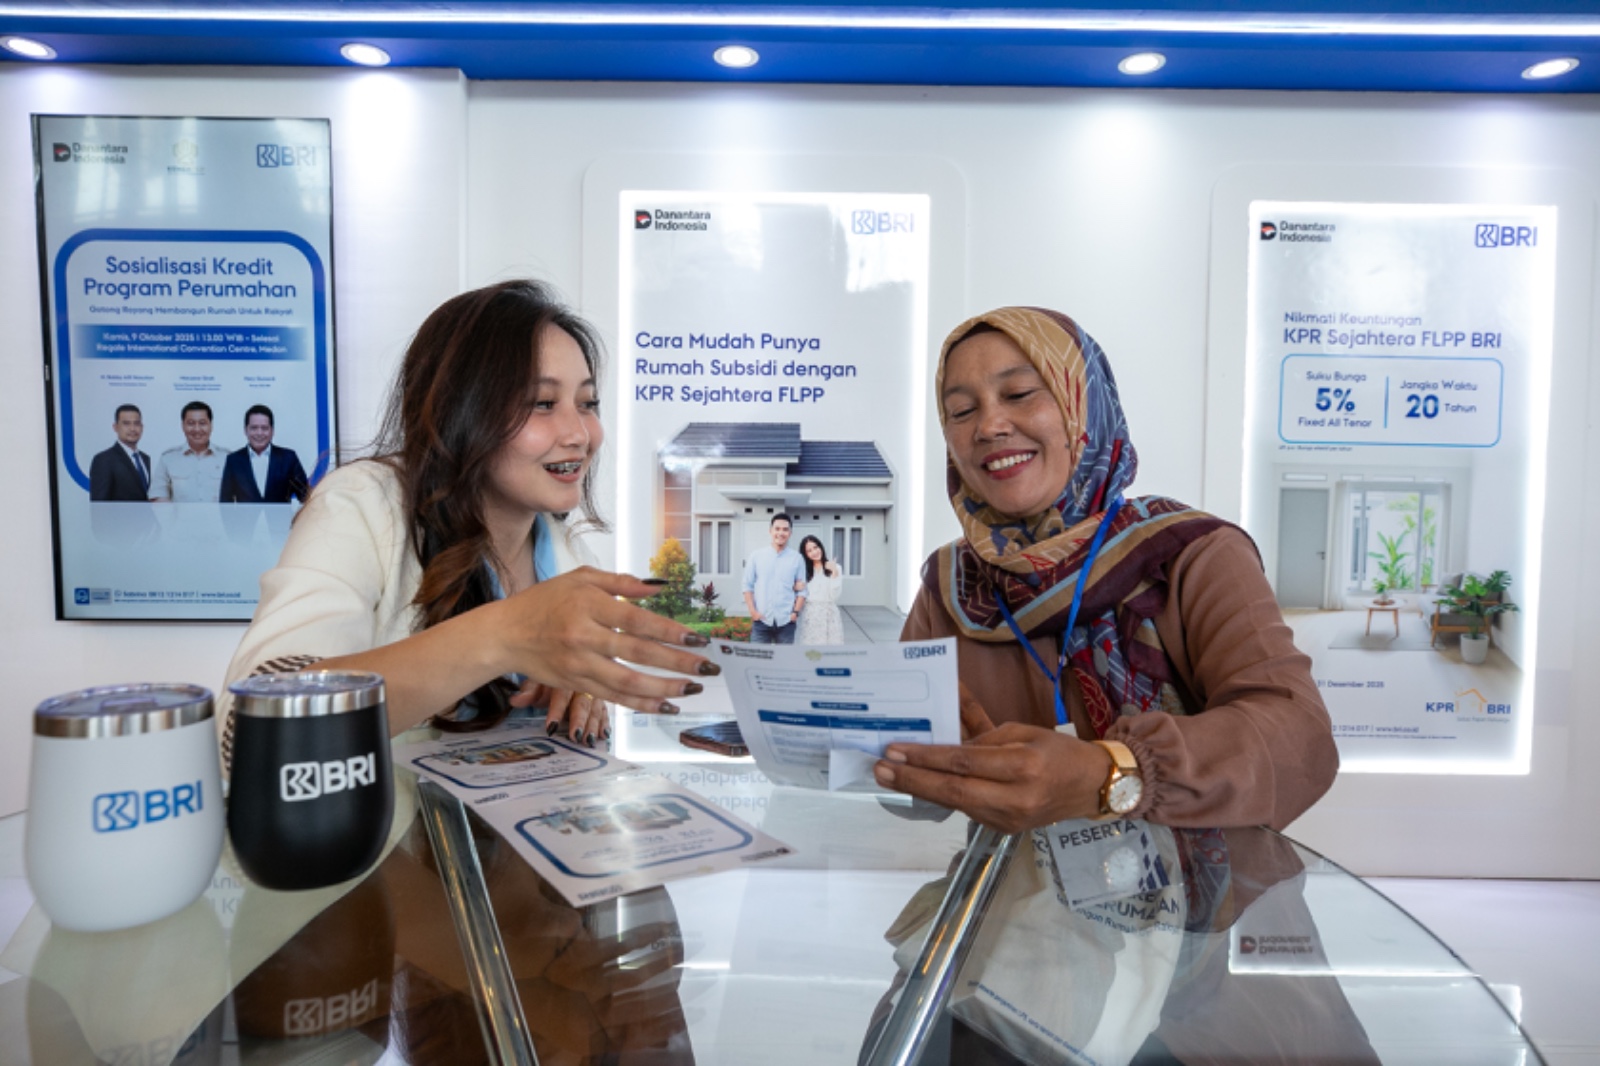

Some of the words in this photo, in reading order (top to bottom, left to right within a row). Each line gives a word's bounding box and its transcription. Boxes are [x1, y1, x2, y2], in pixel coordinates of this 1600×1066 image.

[72, 142, 128, 154] Danantara
[282, 146, 317, 166] BRI
[73, 154, 126, 164] Indonesia
[655, 209, 711, 220] Danantara
[878, 212, 913, 233] BRI
[655, 220, 708, 231] Indonesia
[1280, 221, 1336, 232] Danantara
[1280, 232, 1332, 242] Indonesia
[1501, 226, 1537, 246] BRI
[106, 256, 207, 275] Sosialisasi
[213, 258, 273, 275] Kredit
[84, 279, 172, 300] Program
[178, 280, 296, 298] Perumahan
[208, 307, 236, 315] Rumah
[1284, 312, 1336, 324] Nikmati
[1340, 314, 1422, 328] Keuntungan
[131, 333, 137, 341] 9
[139, 334, 172, 342] Oktober
[636, 332, 682, 349] Cara
[689, 333, 754, 349] Mudah
[761, 334, 820, 352] Punya
[1284, 328, 1321, 344] KPR
[1327, 329, 1416, 348] Sejahtera
[1422, 331, 1465, 347] FLPP
[1472, 333, 1502, 348] BRI
[127, 344, 178, 353] International
[180, 345, 226, 353] Convention
[636, 359, 704, 375] Rumah
[710, 360, 777, 376] Subsidi
[783, 361, 856, 380] dengan
[1306, 371, 1331, 381] Suku
[1334, 372, 1366, 382] Bunga
[1400, 380, 1438, 391] Jangka
[1442, 380, 1477, 391] Waktu
[636, 385, 674, 402] KPR
[681, 386, 772, 405] Sejahtera
[779, 387, 824, 402] FLPP
[1316, 388, 1355, 412] 5%
[1405, 394, 1440, 418] 20
[1444, 402, 1476, 412] Tahun
[1298, 417, 1325, 427] Fixed
[1328, 418, 1341, 427] All
[1344, 418, 1372, 428] Tenor
[920, 645, 946, 658] BRI
[1426, 703, 1454, 712] KPR
[1488, 704, 1510, 714] BRI
[323, 753, 376, 794] BRI
[145, 780, 202, 822] BRI
[1059, 820, 1138, 850] PESERTA
